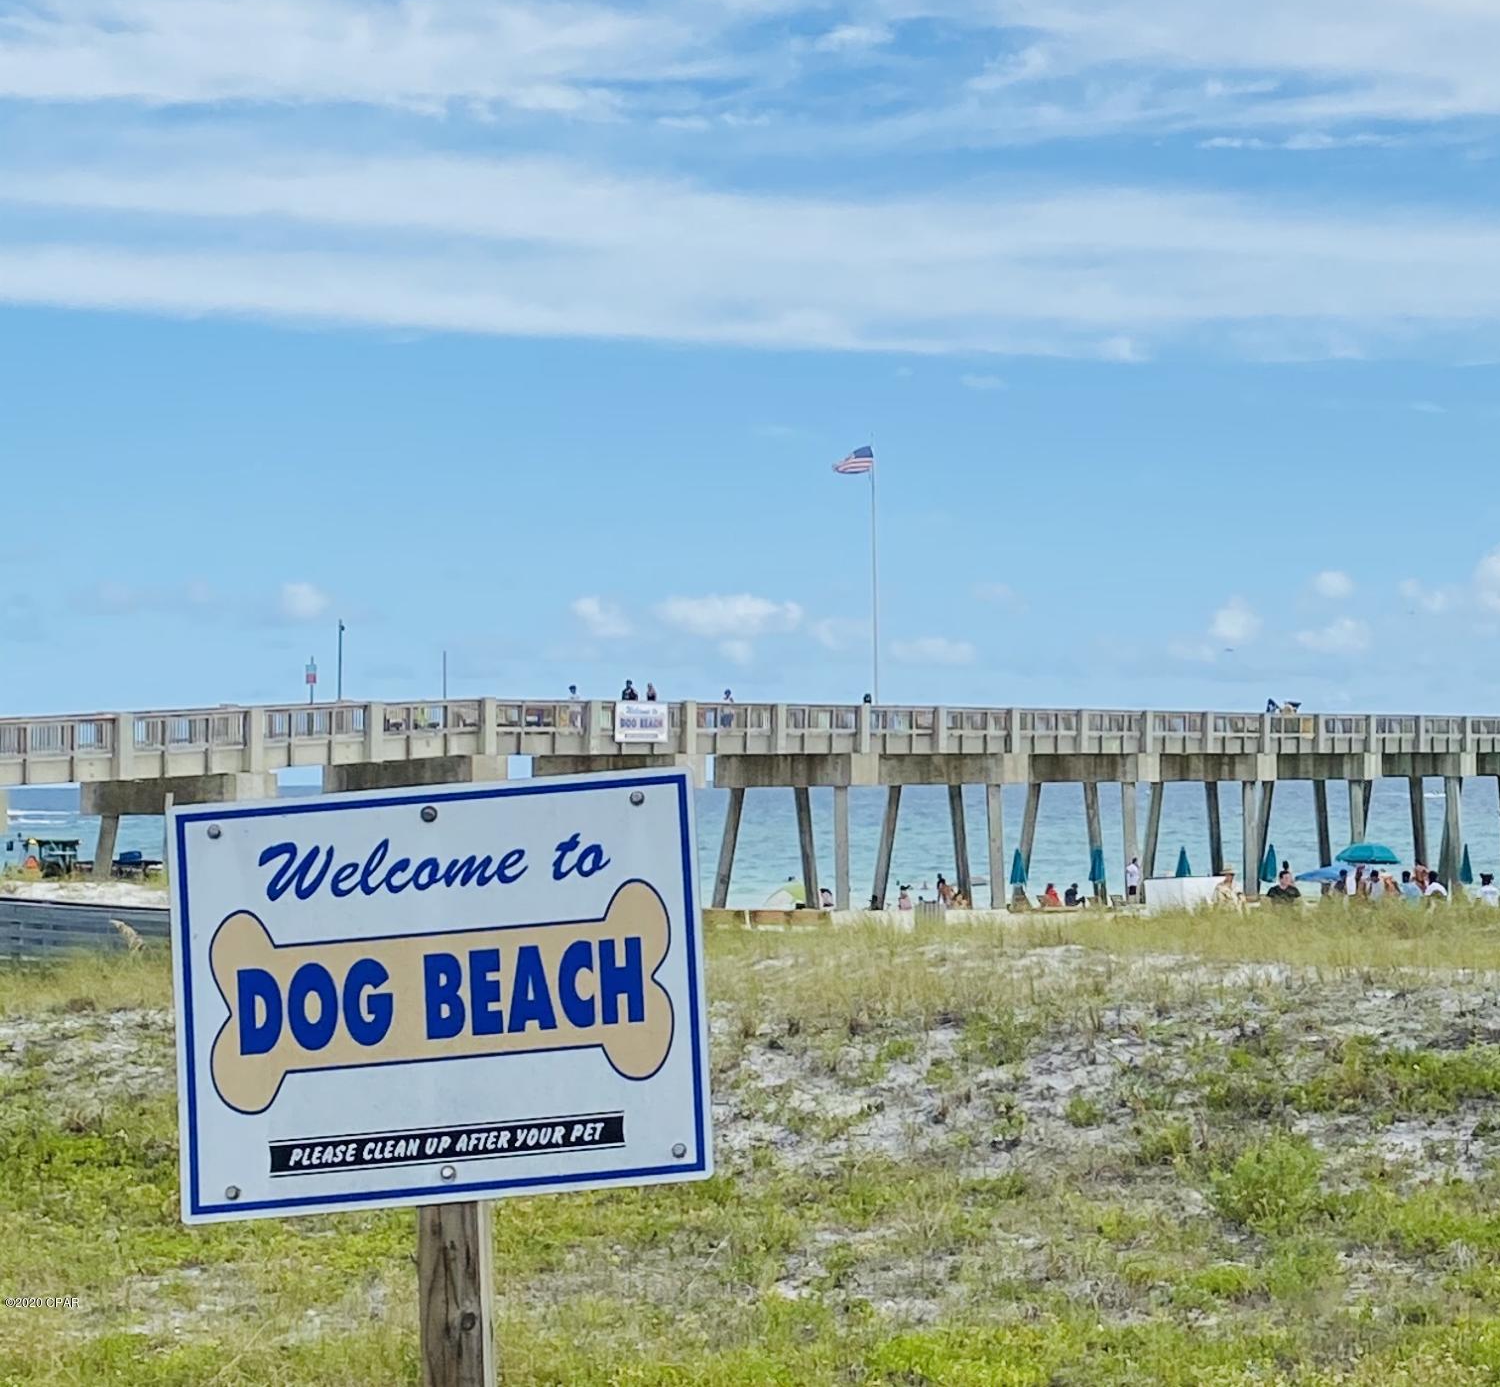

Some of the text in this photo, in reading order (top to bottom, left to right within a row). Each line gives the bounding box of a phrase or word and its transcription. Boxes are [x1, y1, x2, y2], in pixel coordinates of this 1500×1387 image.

[258, 832, 611, 902] Welcome to
[236, 936, 645, 1056] DOG BEACH
[288, 1122, 605, 1167] PLEASE CLEAN UP AFTER YOUR PET
